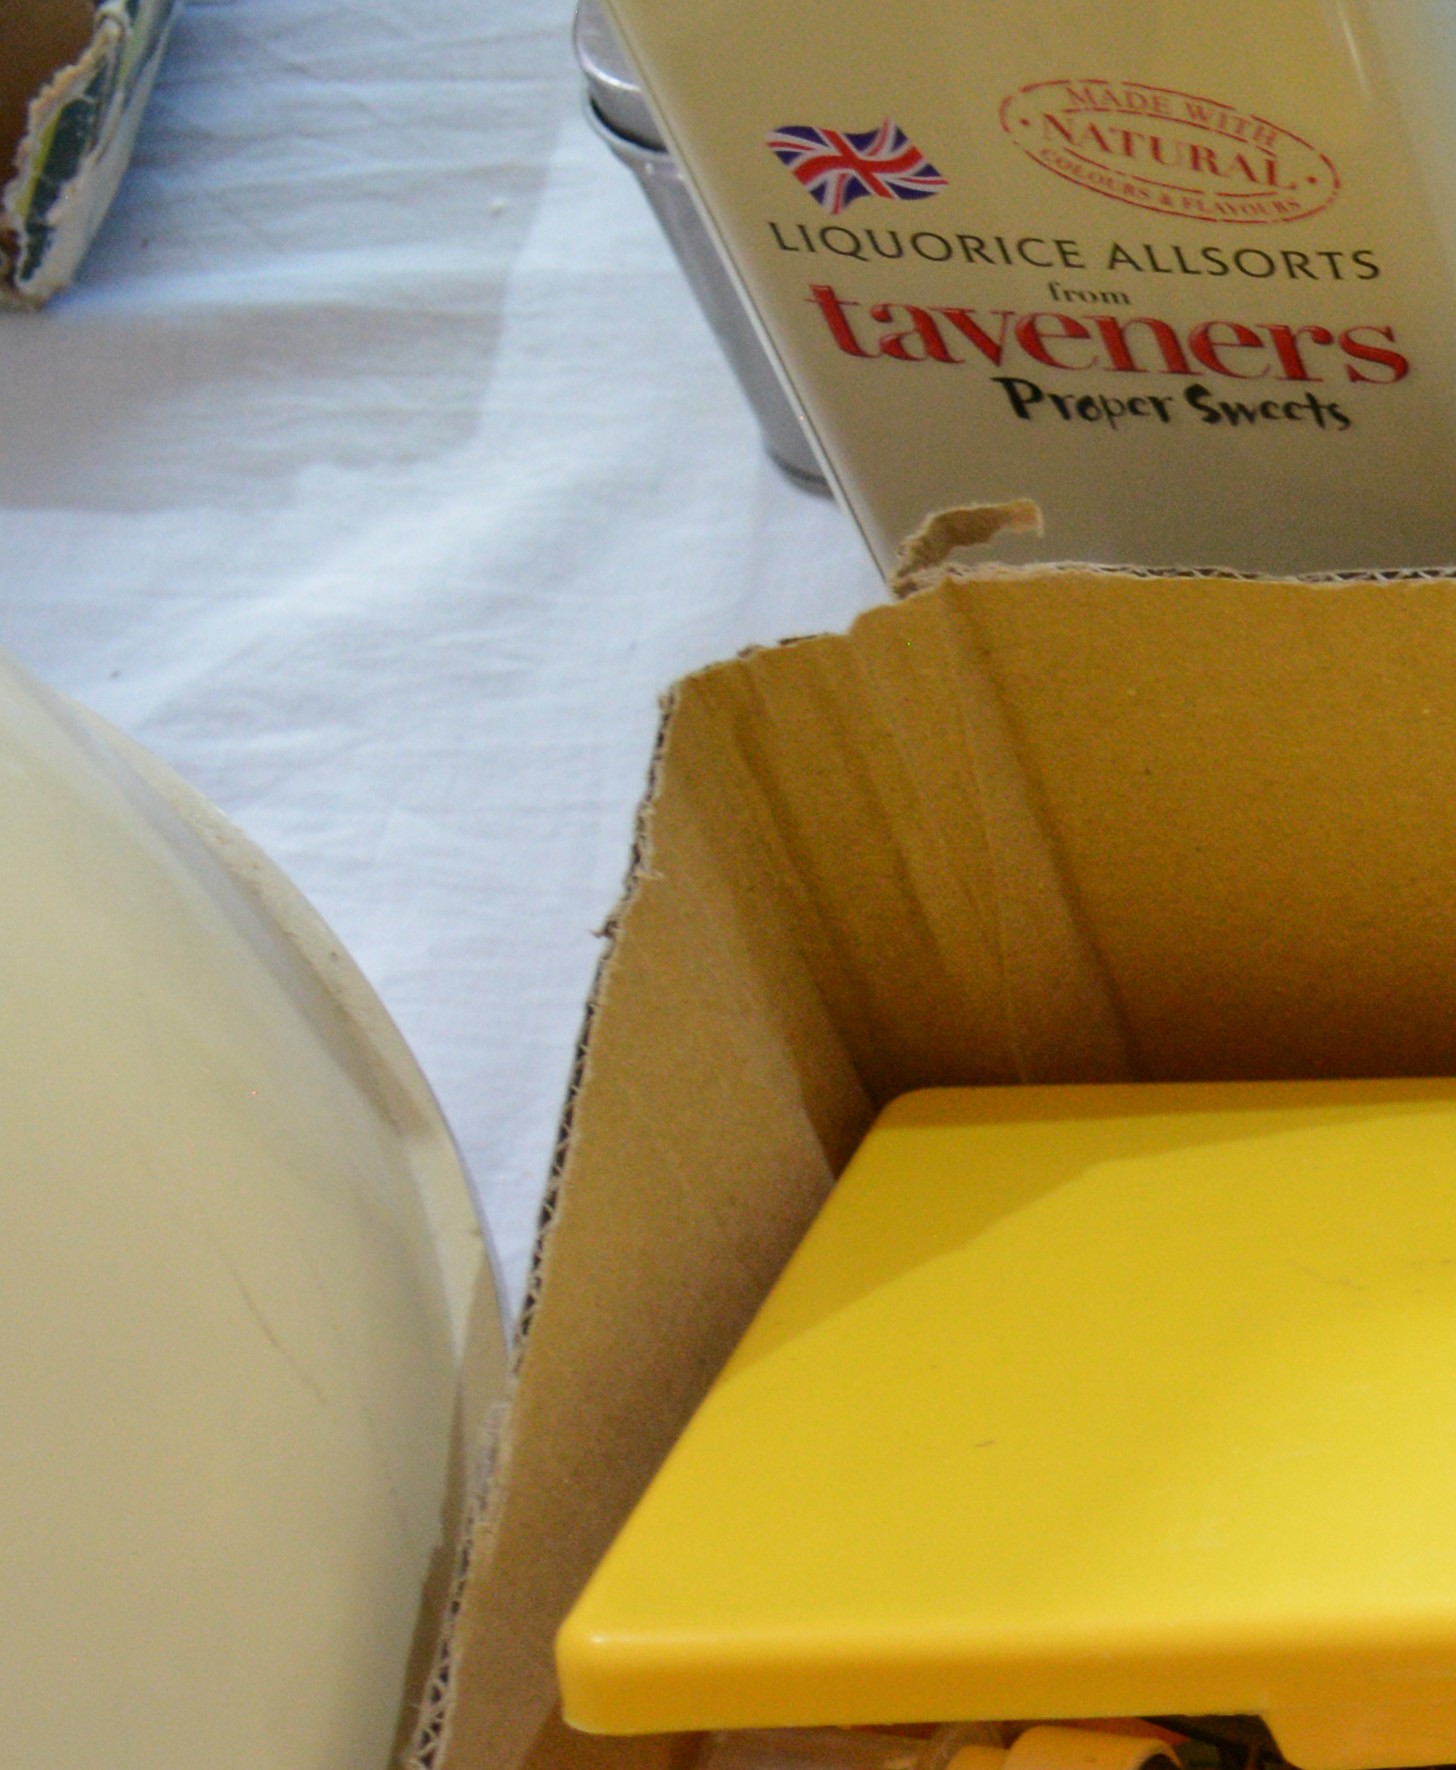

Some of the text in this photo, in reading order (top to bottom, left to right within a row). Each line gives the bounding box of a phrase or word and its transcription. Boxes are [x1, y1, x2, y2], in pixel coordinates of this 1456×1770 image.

[1065, 86, 1280, 147] MADE WITH
[1042, 112, 1298, 190] NATURAL
[1040, 148, 1152, 198] COLOURS
[1180, 195, 1303, 217] FLAVOURS
[767, 220, 1382, 282] LIQUORICE ALLSORTS
[1047, 281, 1133, 306] from
[805, 283, 1412, 386] taveners
[991, 376, 1352, 431] Proper Sweets
